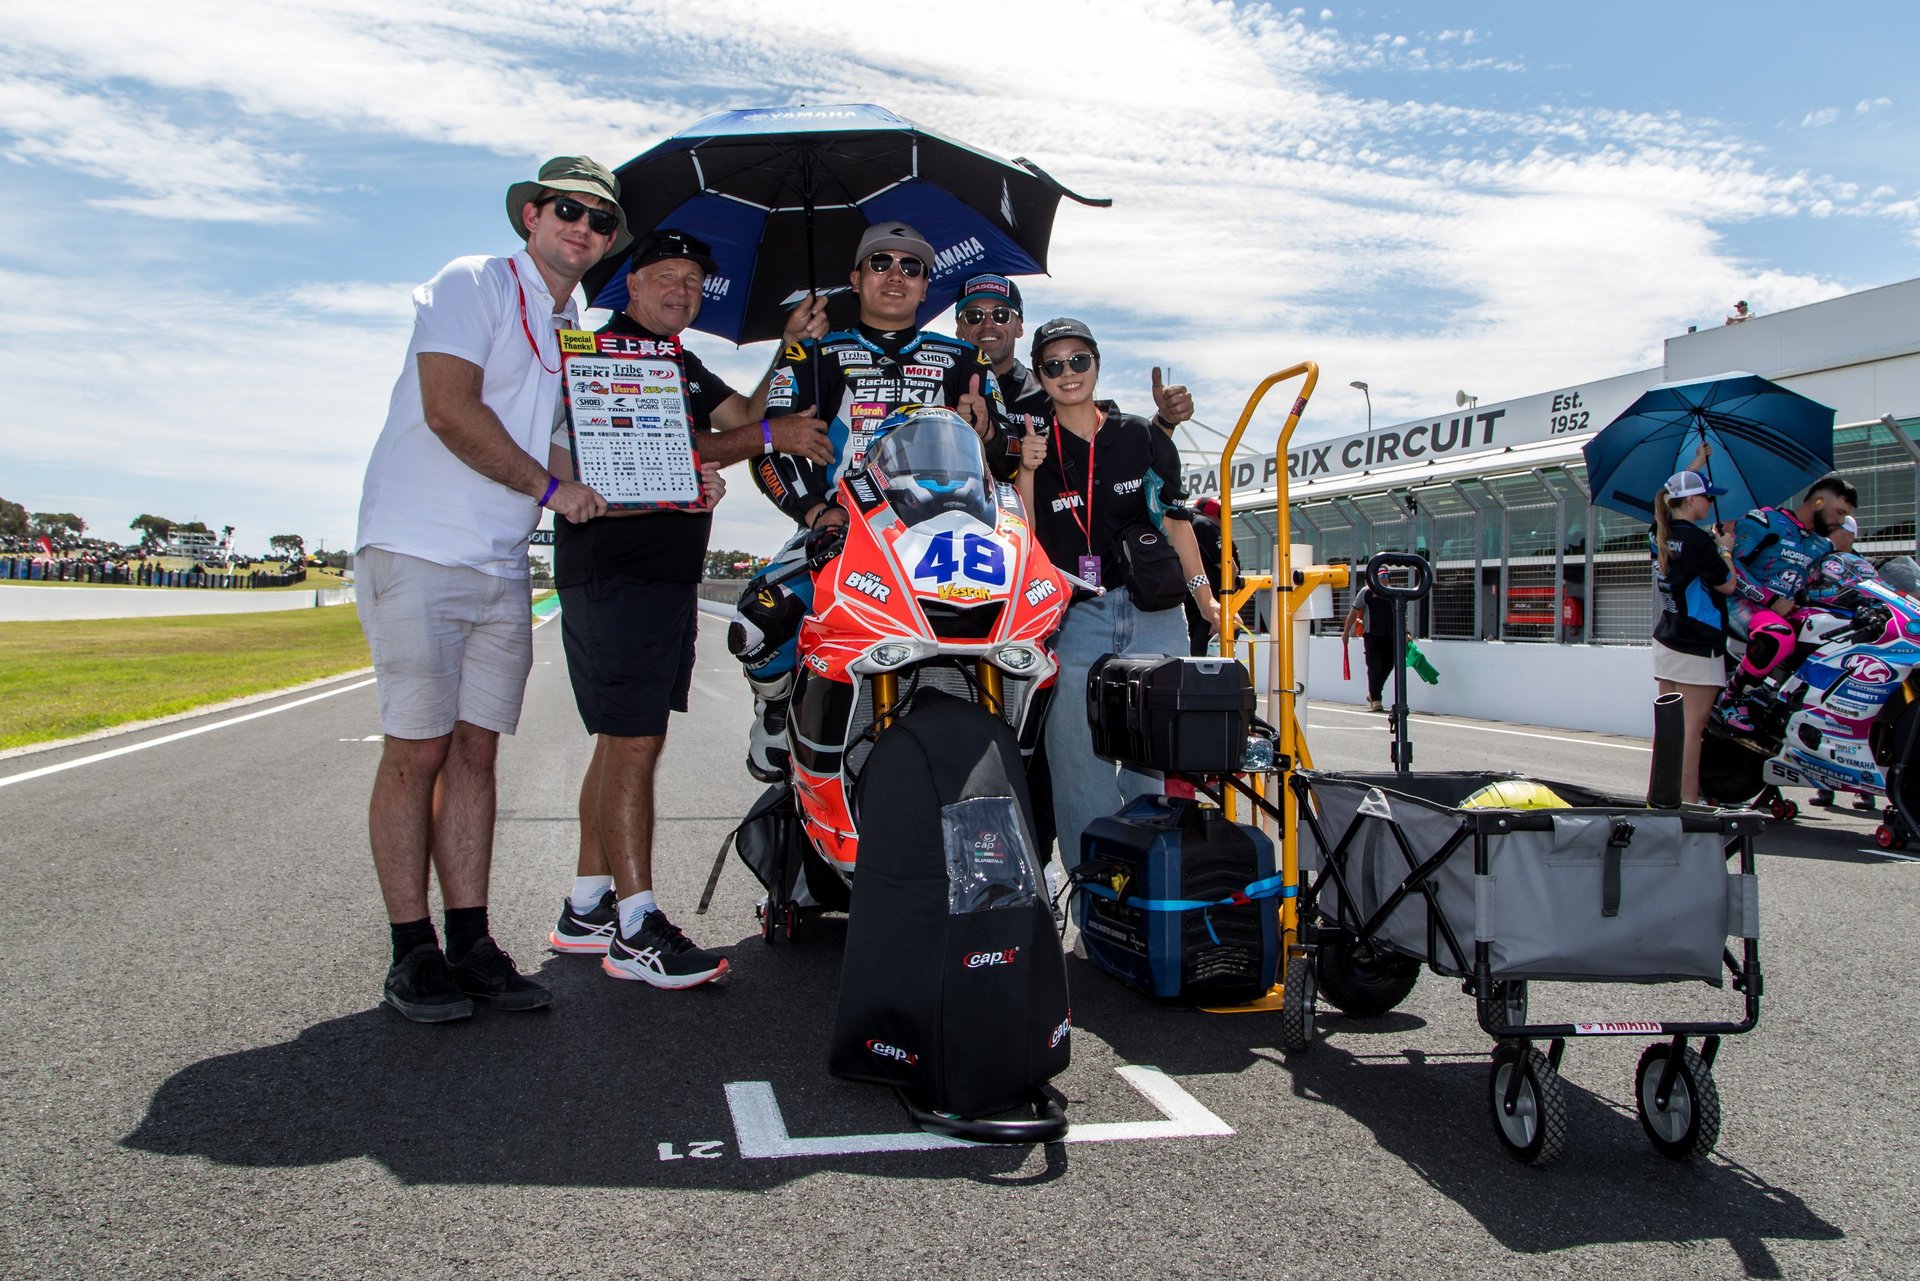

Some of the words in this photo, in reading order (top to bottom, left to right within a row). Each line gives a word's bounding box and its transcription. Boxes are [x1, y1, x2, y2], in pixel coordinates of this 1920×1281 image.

[771, 111, 857, 122] YAMAHA
[967, 283, 1007, 294] GASGAS
[563, 334, 592, 343] Special
[564, 342, 594, 351] Thanks!
[600, 337, 677, 357] 三上真矢
[841, 351, 869, 359] Tribe
[920, 353, 950, 365] SHOEI
[570, 369, 609, 378] SEKI
[612, 363, 642, 374] Tribe
[905, 367, 942, 377] Moty's
[612, 384, 640, 394] Vesrah
[857, 378, 900, 387] Racing
[903, 379, 935, 388] Team
[854, 387, 935, 405] SEKI
[1552, 390, 1583, 413] Est.
[852, 405, 883, 416] Vesrah
[1015, 413, 1045, 425] YAAHA
[1550, 410, 1590, 435] 1952
[1263, 445, 1333, 483] PRIX
[1342, 409, 1507, 469] CIRCUIT
[850, 476, 877, 503] YAMAHA
[914, 530, 1006, 586] 48
[865, 571, 883, 582] TEAM
[1029, 578, 1040, 587] TEAM
[845, 572, 891, 604] BWR
[937, 582, 992, 601] Vesrah
[1025, 579, 1058, 607] BWR
[747, 642, 766, 657] TAICHI
[807, 654, 829, 673] R6
[1844, 759, 1876, 771] YAMAHA
[1772, 763, 1800, 783] 55
[1800, 761, 1854, 782] MICHELIN
[968, 948, 1016, 967] capit
